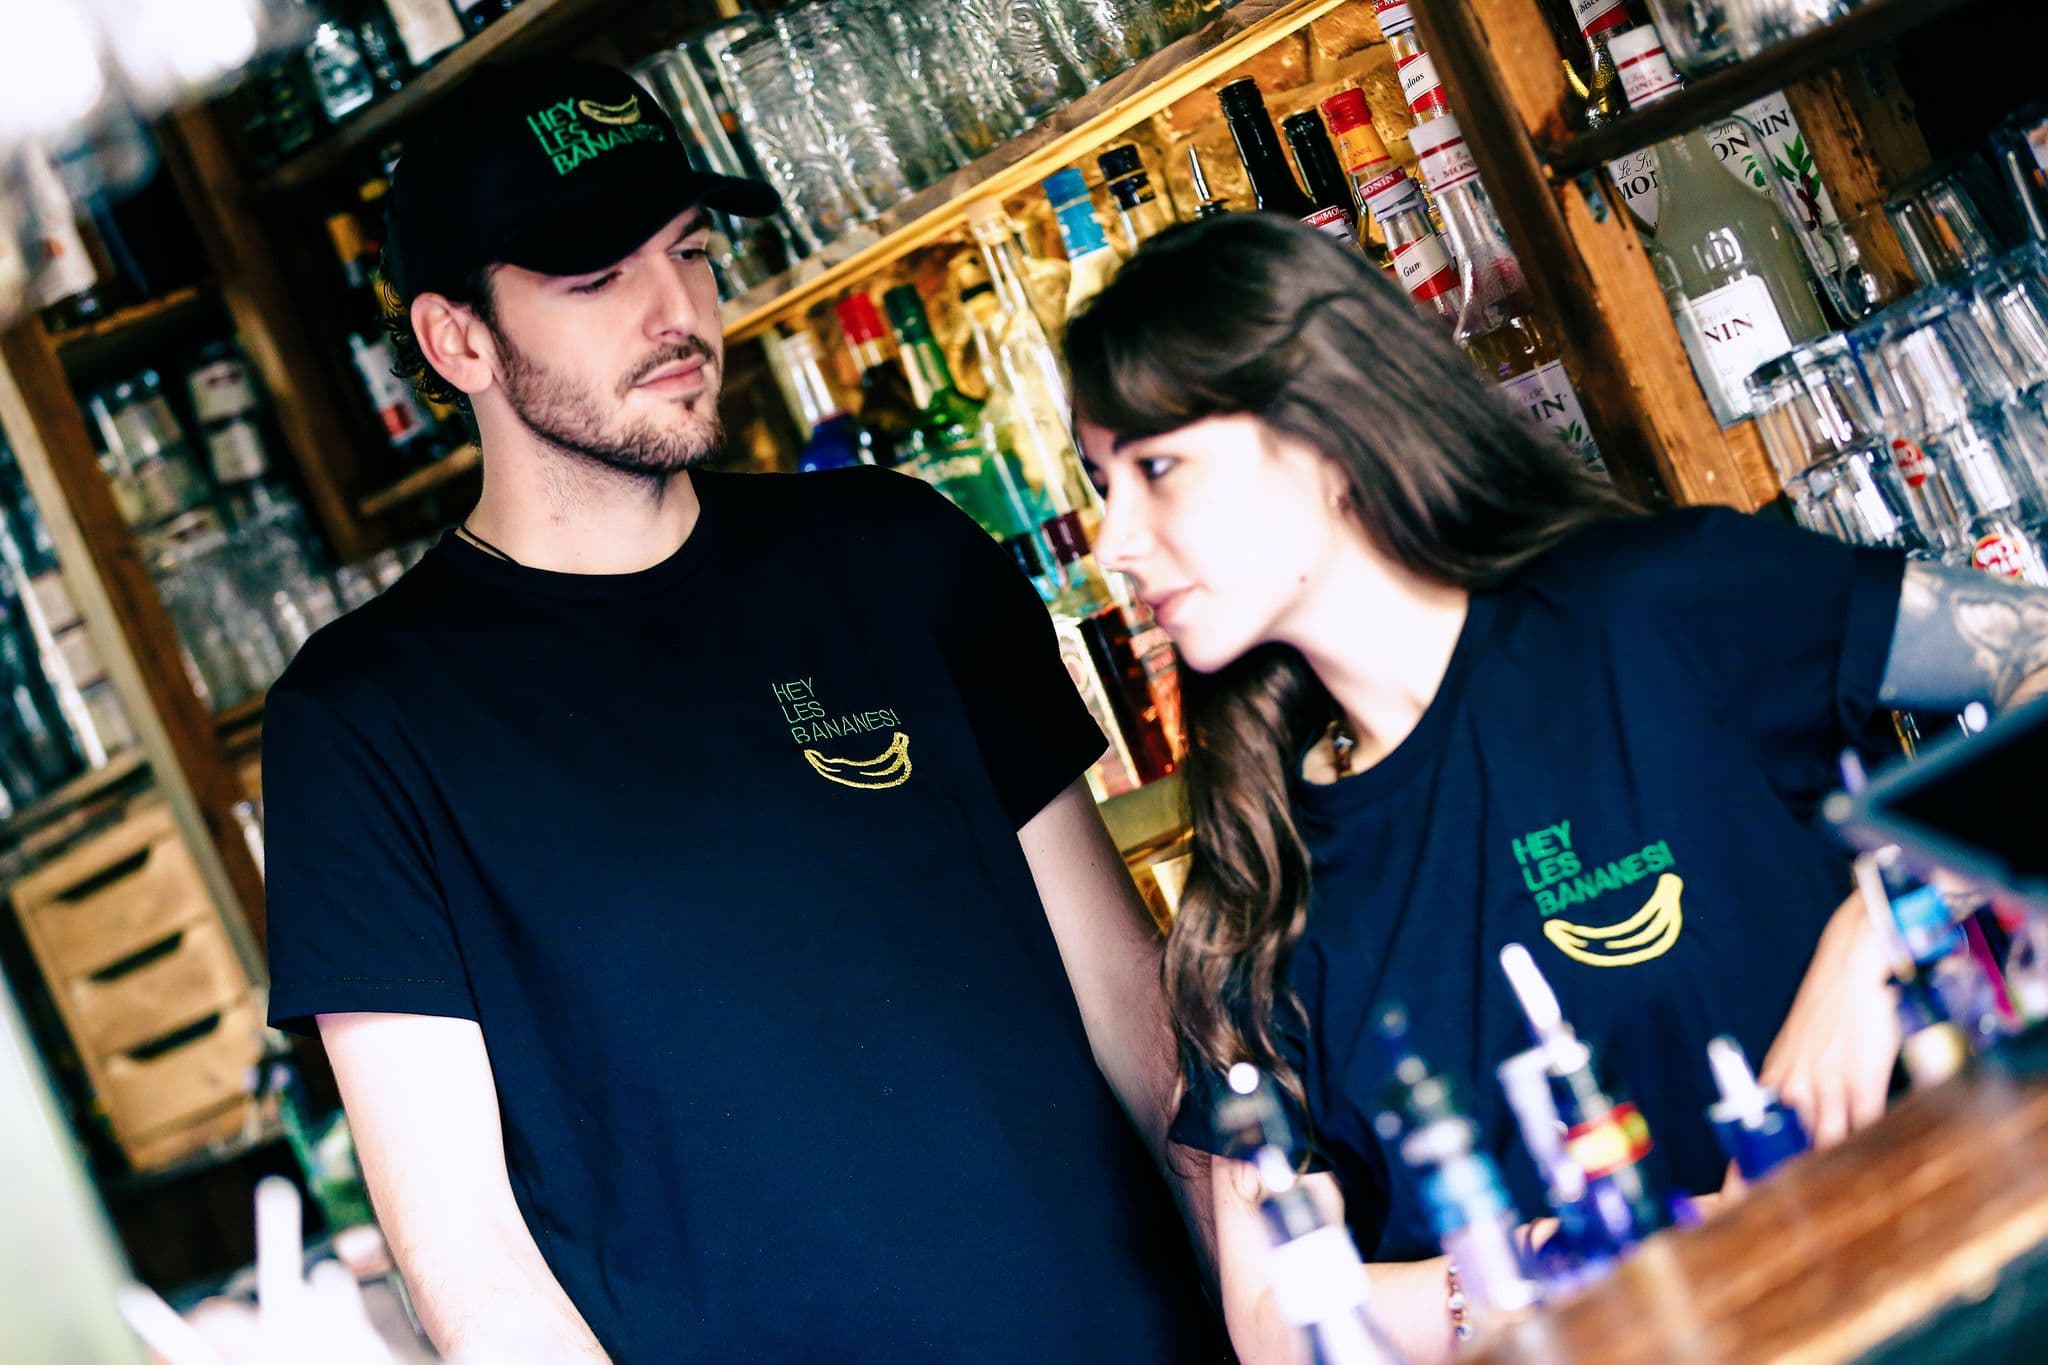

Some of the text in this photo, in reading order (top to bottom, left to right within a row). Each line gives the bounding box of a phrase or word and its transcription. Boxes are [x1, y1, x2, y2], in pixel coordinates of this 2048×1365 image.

[526, 97, 577, 131] HEY
[539, 122, 590, 156] LES
[552, 123, 665, 176] BANAN
[1618, 160, 1632, 180] Le
[771, 677, 815, 703] HEY
[781, 700, 826, 724] LES
[791, 708, 902, 745] BANANES!
[1511, 819, 1572, 865] HEY
[1522, 851, 1582, 892] LES
[1534, 839, 1675, 917] BANANES!
